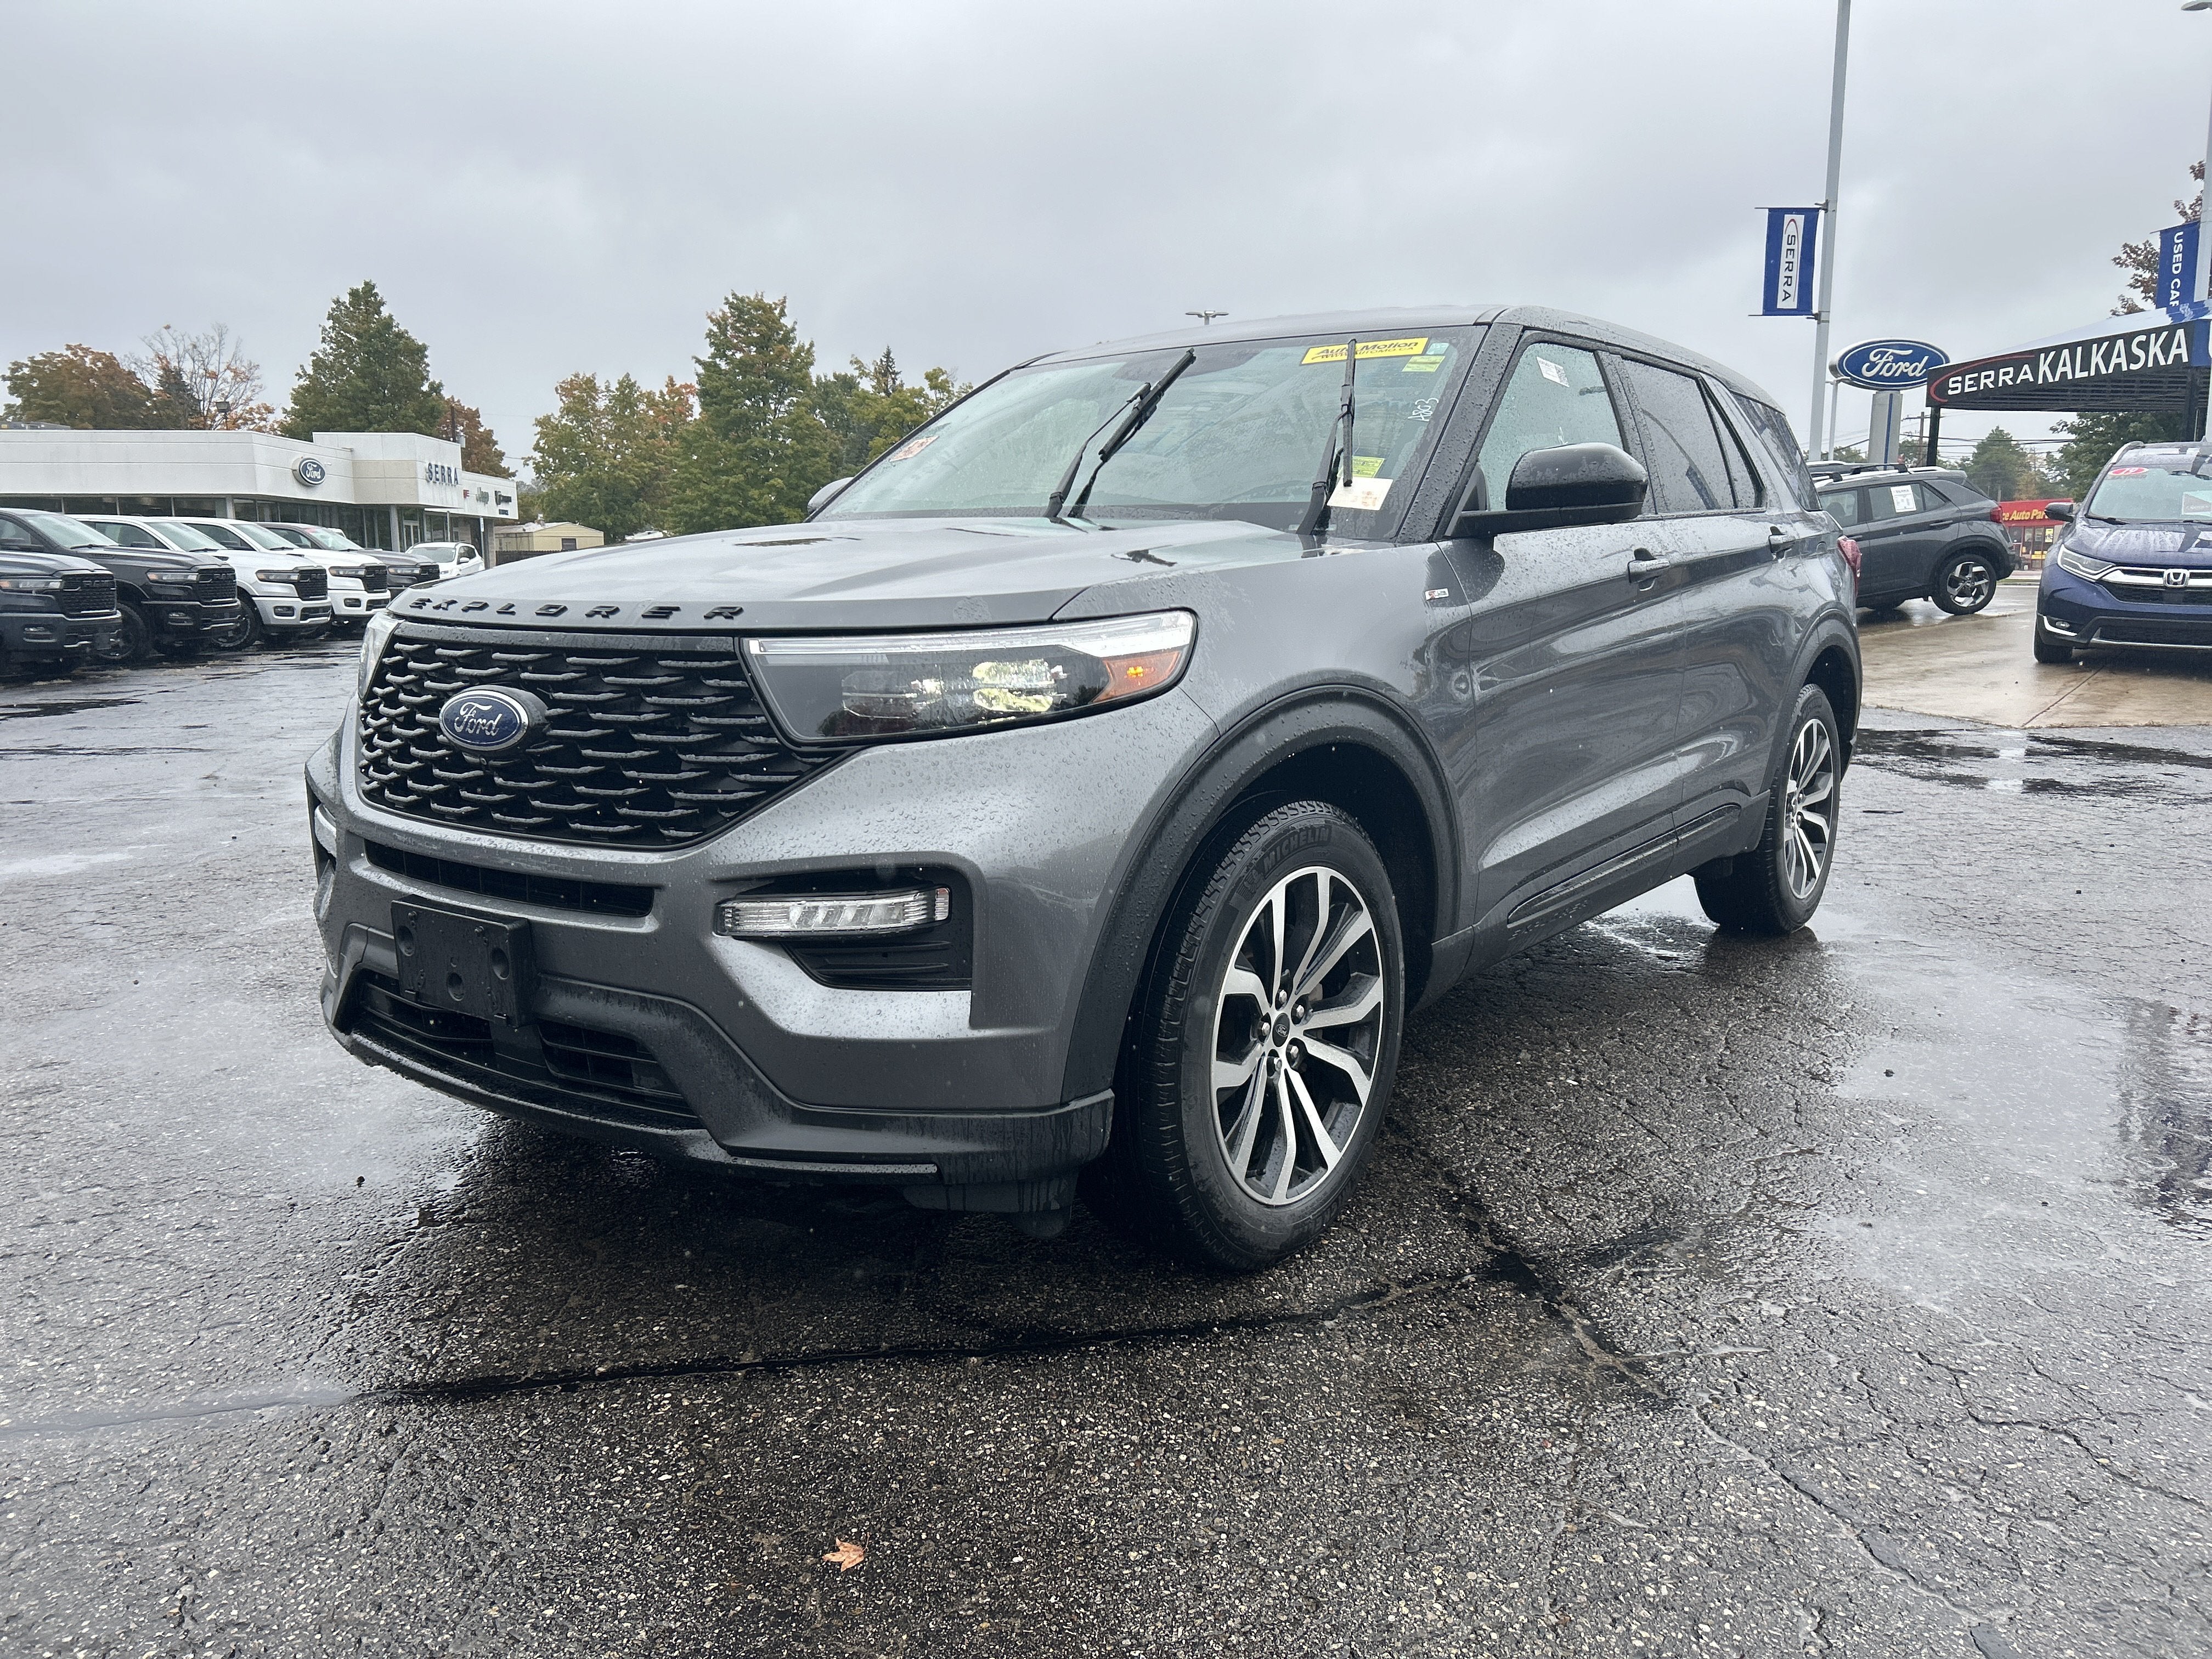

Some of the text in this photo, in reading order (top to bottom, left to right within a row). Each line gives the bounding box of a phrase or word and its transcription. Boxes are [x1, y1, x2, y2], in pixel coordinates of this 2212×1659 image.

[2171, 231, 2184, 275] USED
[1782, 234, 1796, 302] SERRA
[1360, 342, 1418, 352] Motion
[1861, 348, 1929, 377] Ford
[1948, 364, 2034, 396] SERRA
[2038, 328, 2188, 385] KALKASKA
[306, 462, 321, 479] Ford
[428, 462, 459, 485] SERRA
[2009, 510, 2030, 520] Auto
[2030, 509, 2049, 520] Par
[409, 597, 744, 620] EXPLORER
[454, 702, 503, 736] Ford
[1263, 826, 1330, 874] MICHELIN
